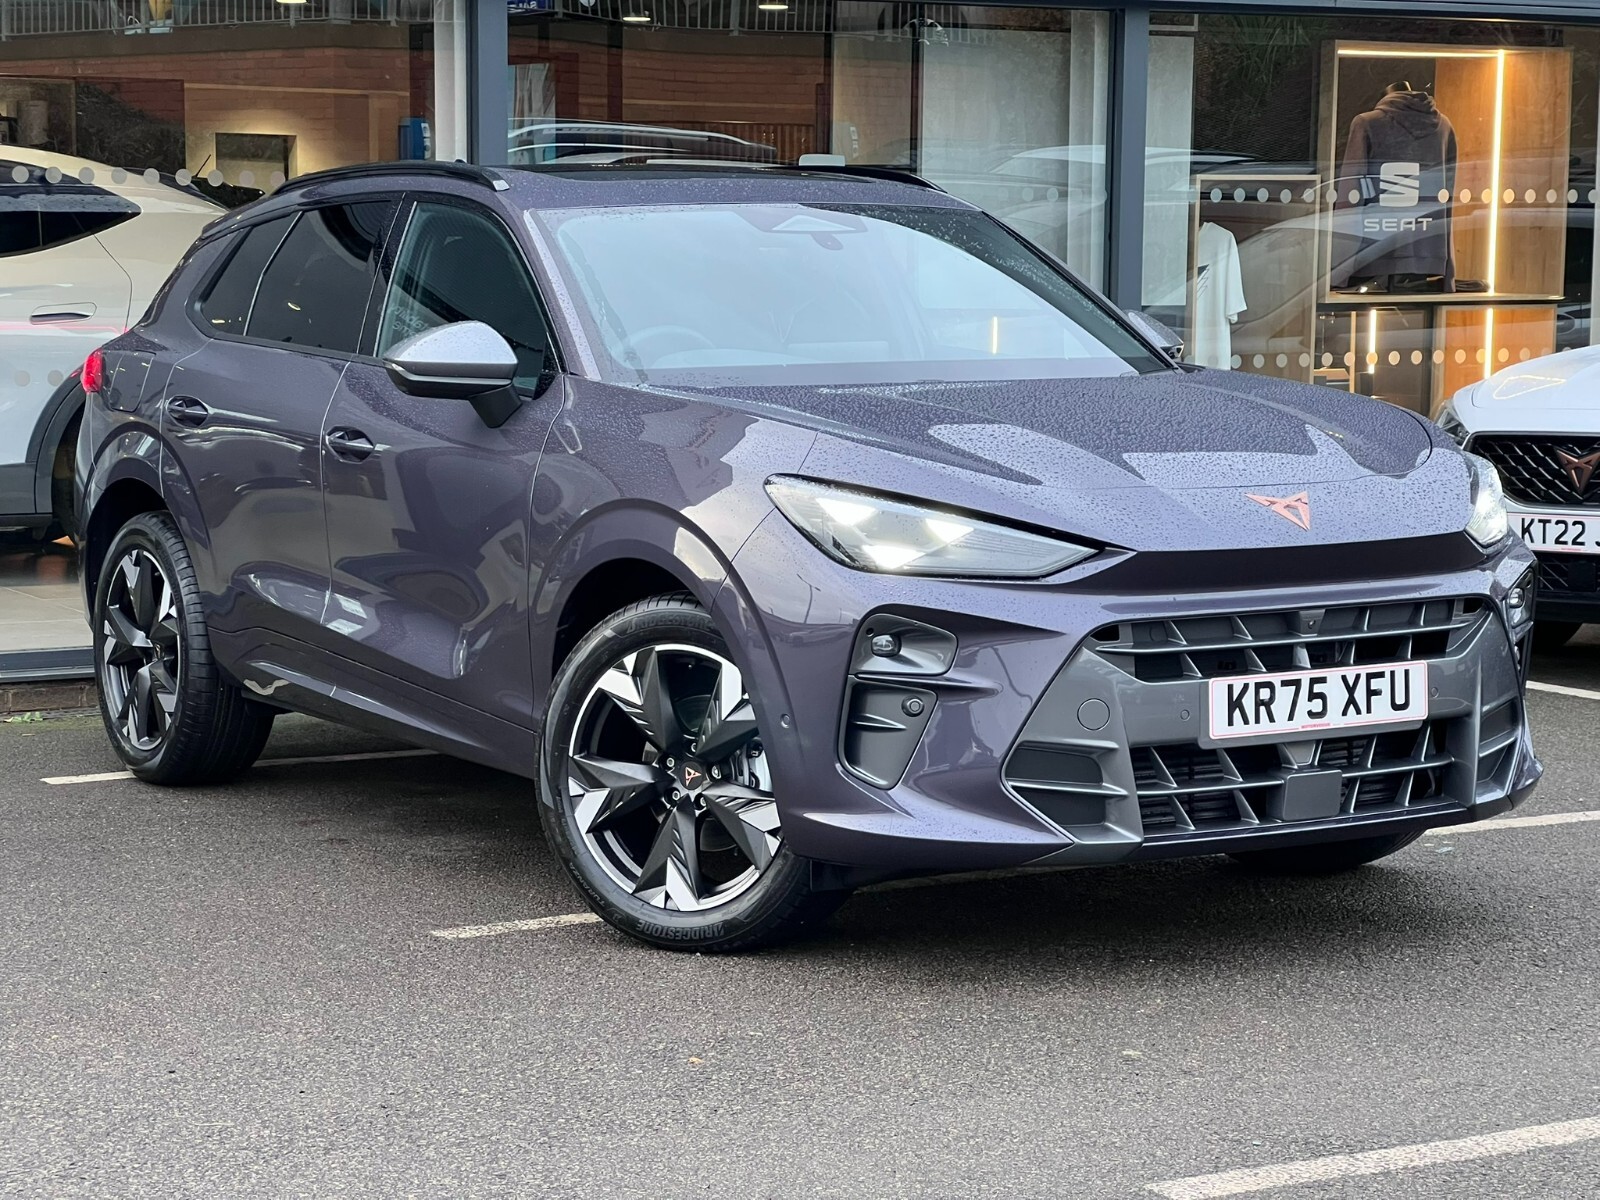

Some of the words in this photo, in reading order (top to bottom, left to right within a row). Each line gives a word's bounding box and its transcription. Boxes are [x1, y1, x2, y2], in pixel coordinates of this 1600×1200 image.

[1363, 217, 1433, 232] SEAT
[1521, 517, 1586, 546] KT22
[1227, 676, 1328, 727] KR75
[1341, 668, 1411, 717] XFU
[636, 919, 725, 940] BRIDGESTONE
